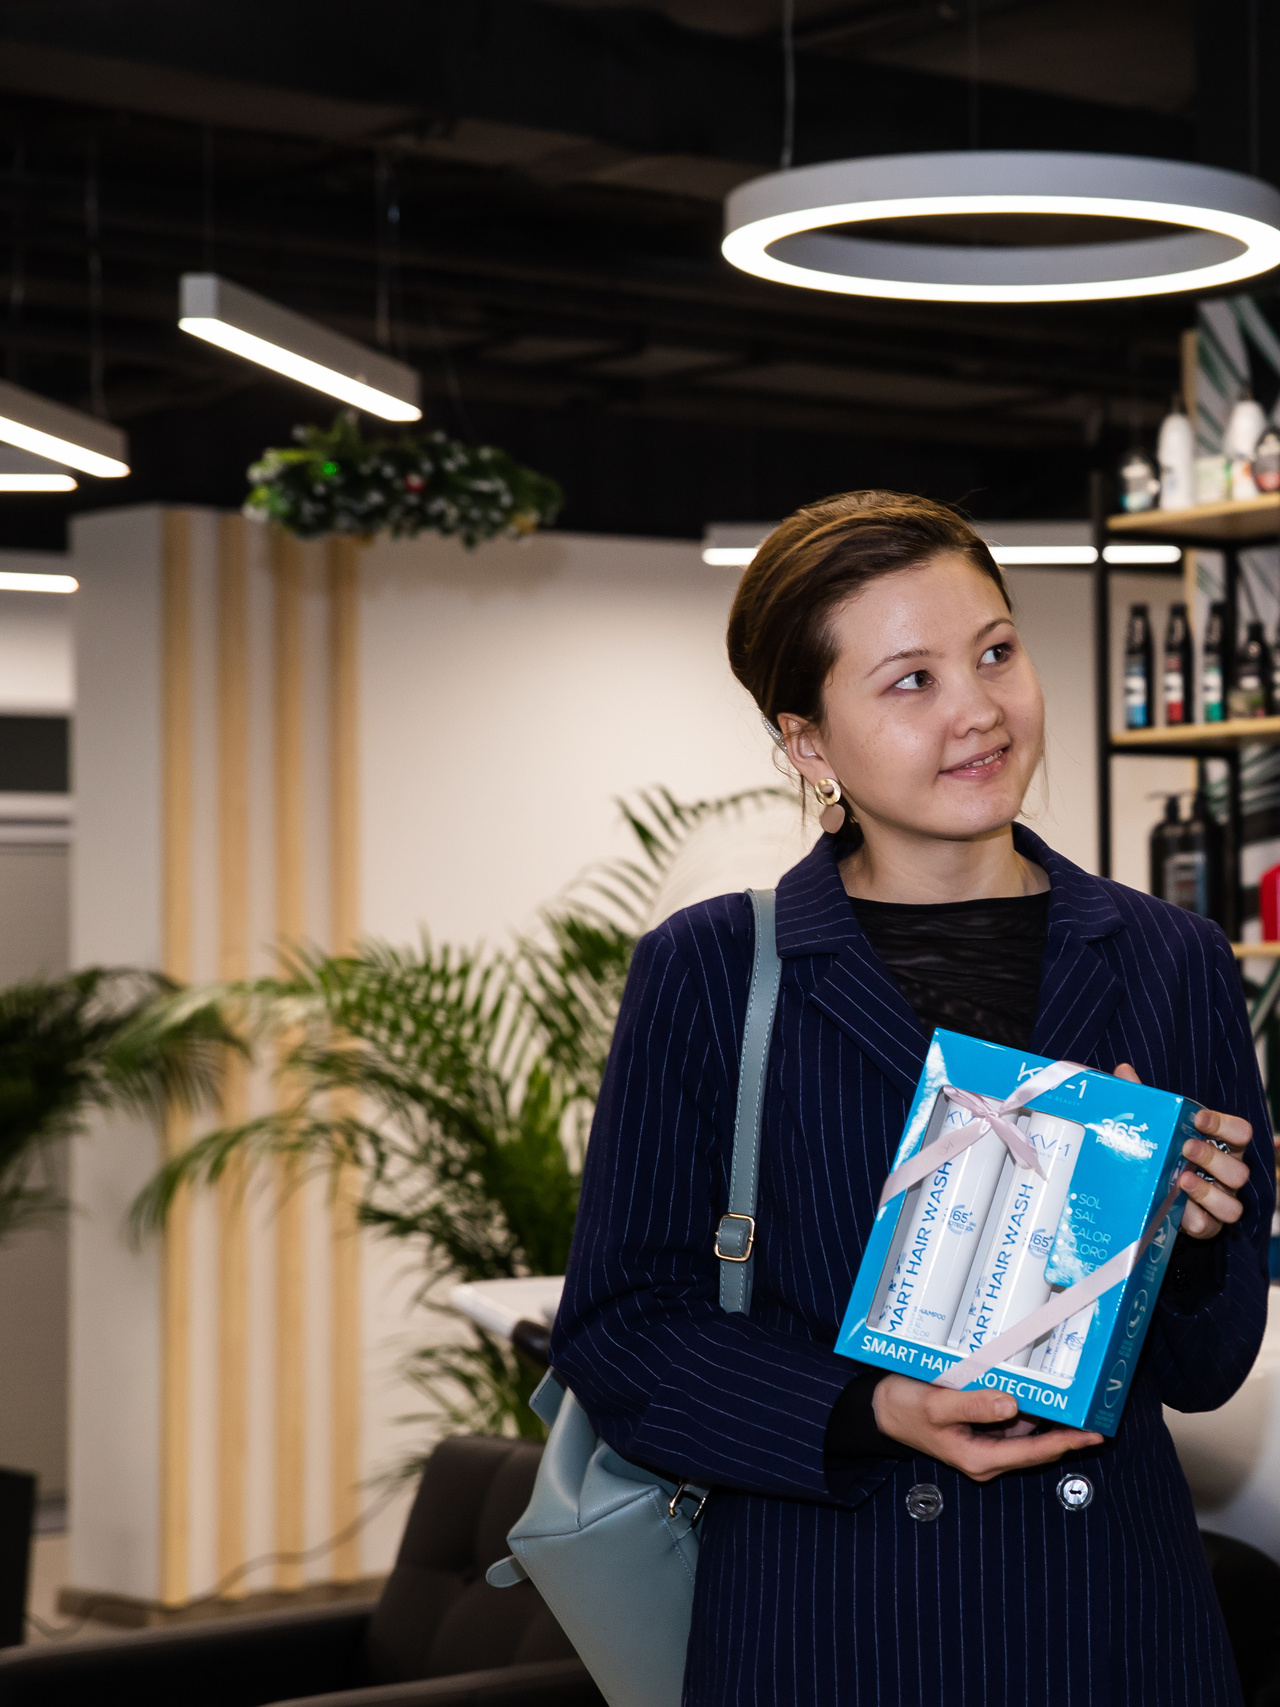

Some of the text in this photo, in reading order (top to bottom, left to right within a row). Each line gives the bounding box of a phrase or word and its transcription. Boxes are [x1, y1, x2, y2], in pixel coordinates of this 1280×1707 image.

[1017, 1062, 1087, 1099] K-1
[945, 1109, 976, 1127] KV
[1077, 1193, 1102, 1210] SOL
[1073, 1208, 1096, 1225] SAL
[888, 1278, 915, 1333] MART
[906, 1226, 932, 1276] HAIR
[922, 1160, 953, 1223] WASH
[1070, 1224, 1112, 1246] CALOR
[969, 1183, 1034, 1353] MART HAIR WASH
[861, 1335, 919, 1365] SMART
[973, 1372, 1069, 1411] ROTECTION
